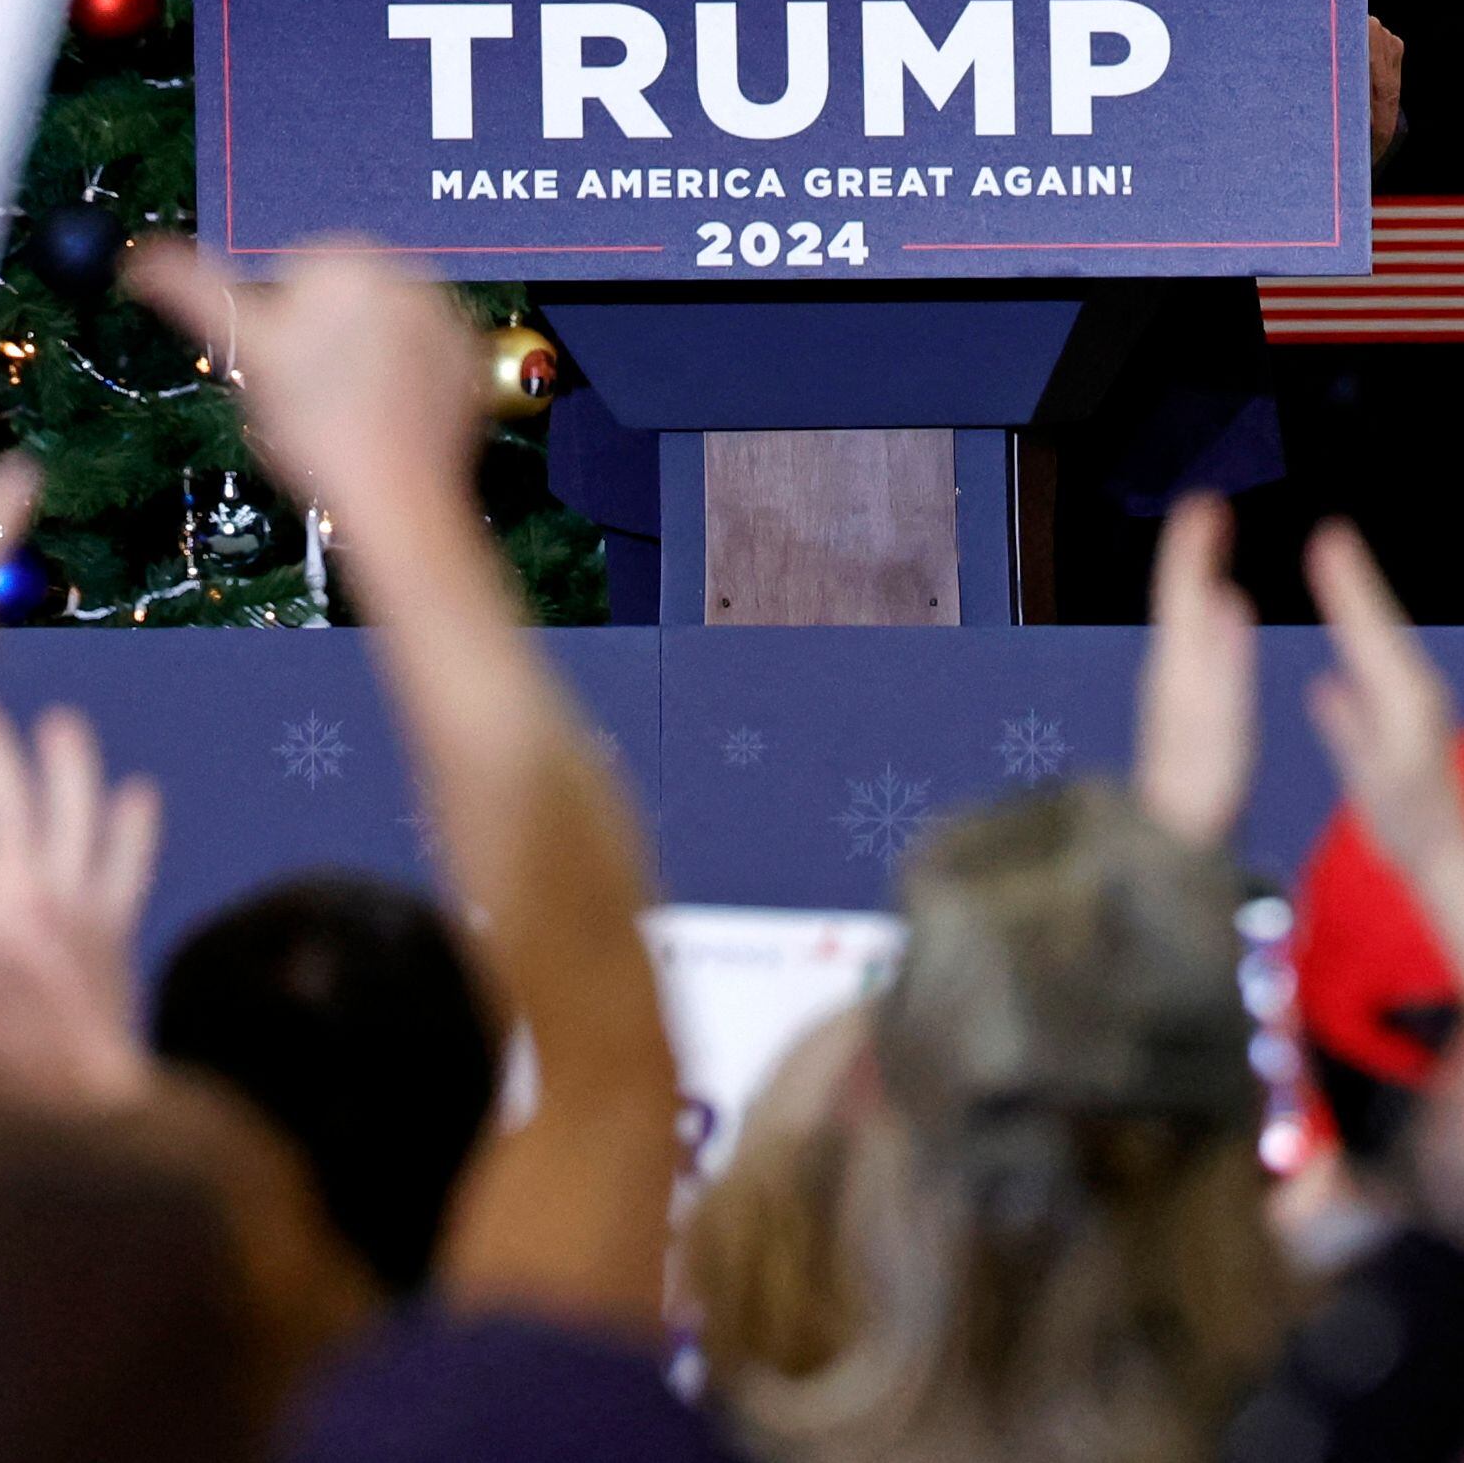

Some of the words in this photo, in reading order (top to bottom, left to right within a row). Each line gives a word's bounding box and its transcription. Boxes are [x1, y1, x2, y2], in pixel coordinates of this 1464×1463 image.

[431, 168, 560, 200] MAKE
[576, 167, 786, 199] AMERICA
[804, 166, 953, 198] GREAT
[971, 165, 1134, 197] AGAIN!
[695, 221, 870, 267] 2024
